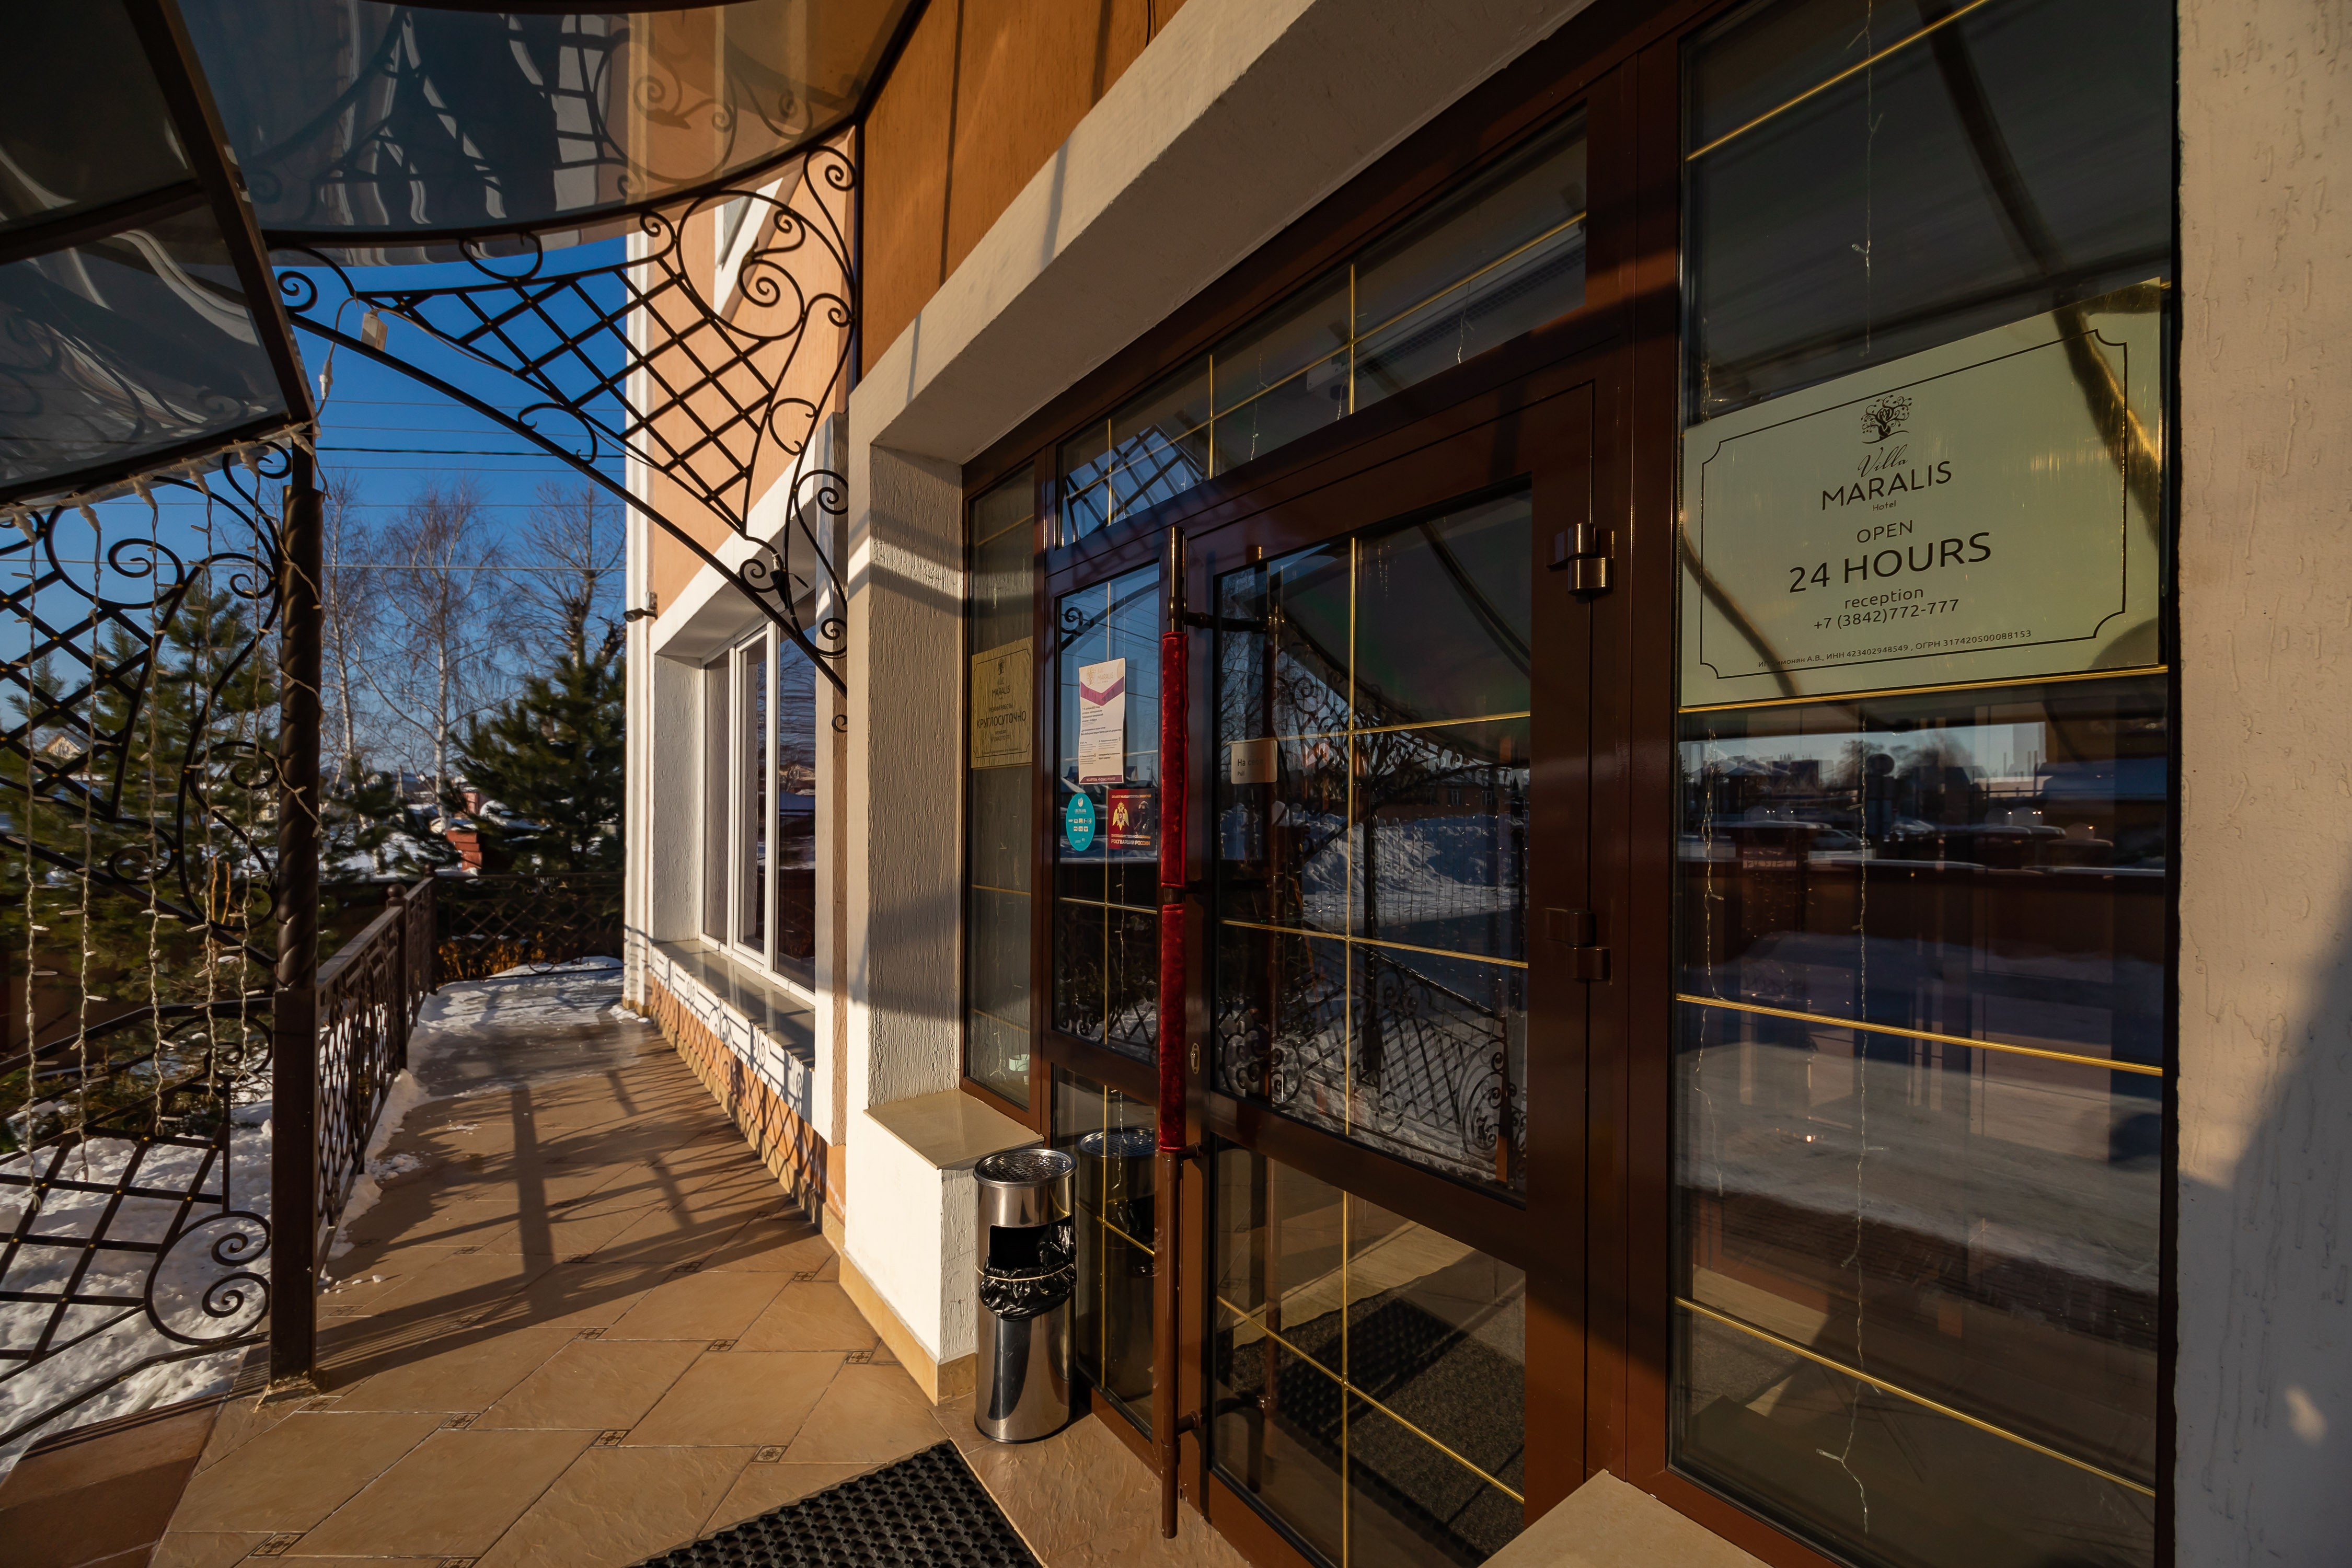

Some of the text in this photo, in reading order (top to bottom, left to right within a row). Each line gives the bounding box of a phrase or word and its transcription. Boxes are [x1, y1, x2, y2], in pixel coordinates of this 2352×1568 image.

[1858, 444, 1908, 478] Villa
[1822, 461, 1952, 510] MARALIS
[1872, 500, 1896, 511] Hotel
[1857, 520, 1912, 543] OPEN
[1789, 532, 1991, 593] 24 HOURS
[1814, 599, 1959, 629] +7 (3842)772-777
[1844, 589, 1923, 609] reception
[1827, 652, 1844, 660] ИНН
[1847, 644, 1908, 657] 423402948549
[1916, 640, 1940, 650] ОГРН
[1943, 630, 2032, 647] 317420500088153
[977, 711, 1027, 729] КРУГЛОСУТОЧНО
